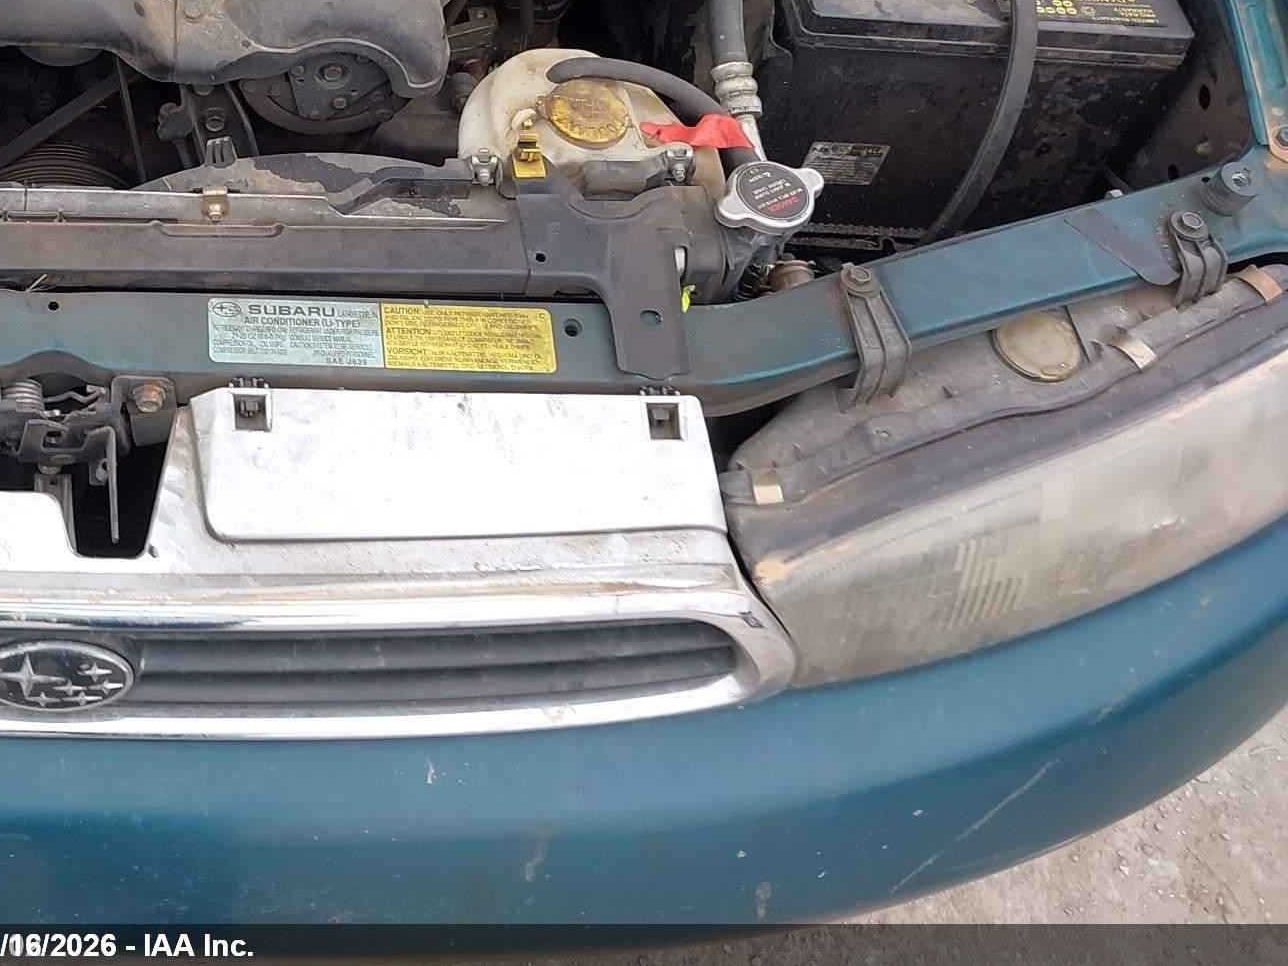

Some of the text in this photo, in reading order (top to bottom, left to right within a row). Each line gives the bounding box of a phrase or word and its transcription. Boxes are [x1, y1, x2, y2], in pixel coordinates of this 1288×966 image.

[248, 304, 335, 317] SUBARU
[244, 317, 360, 328] AIR CONDITIONER (U-TYPE)
